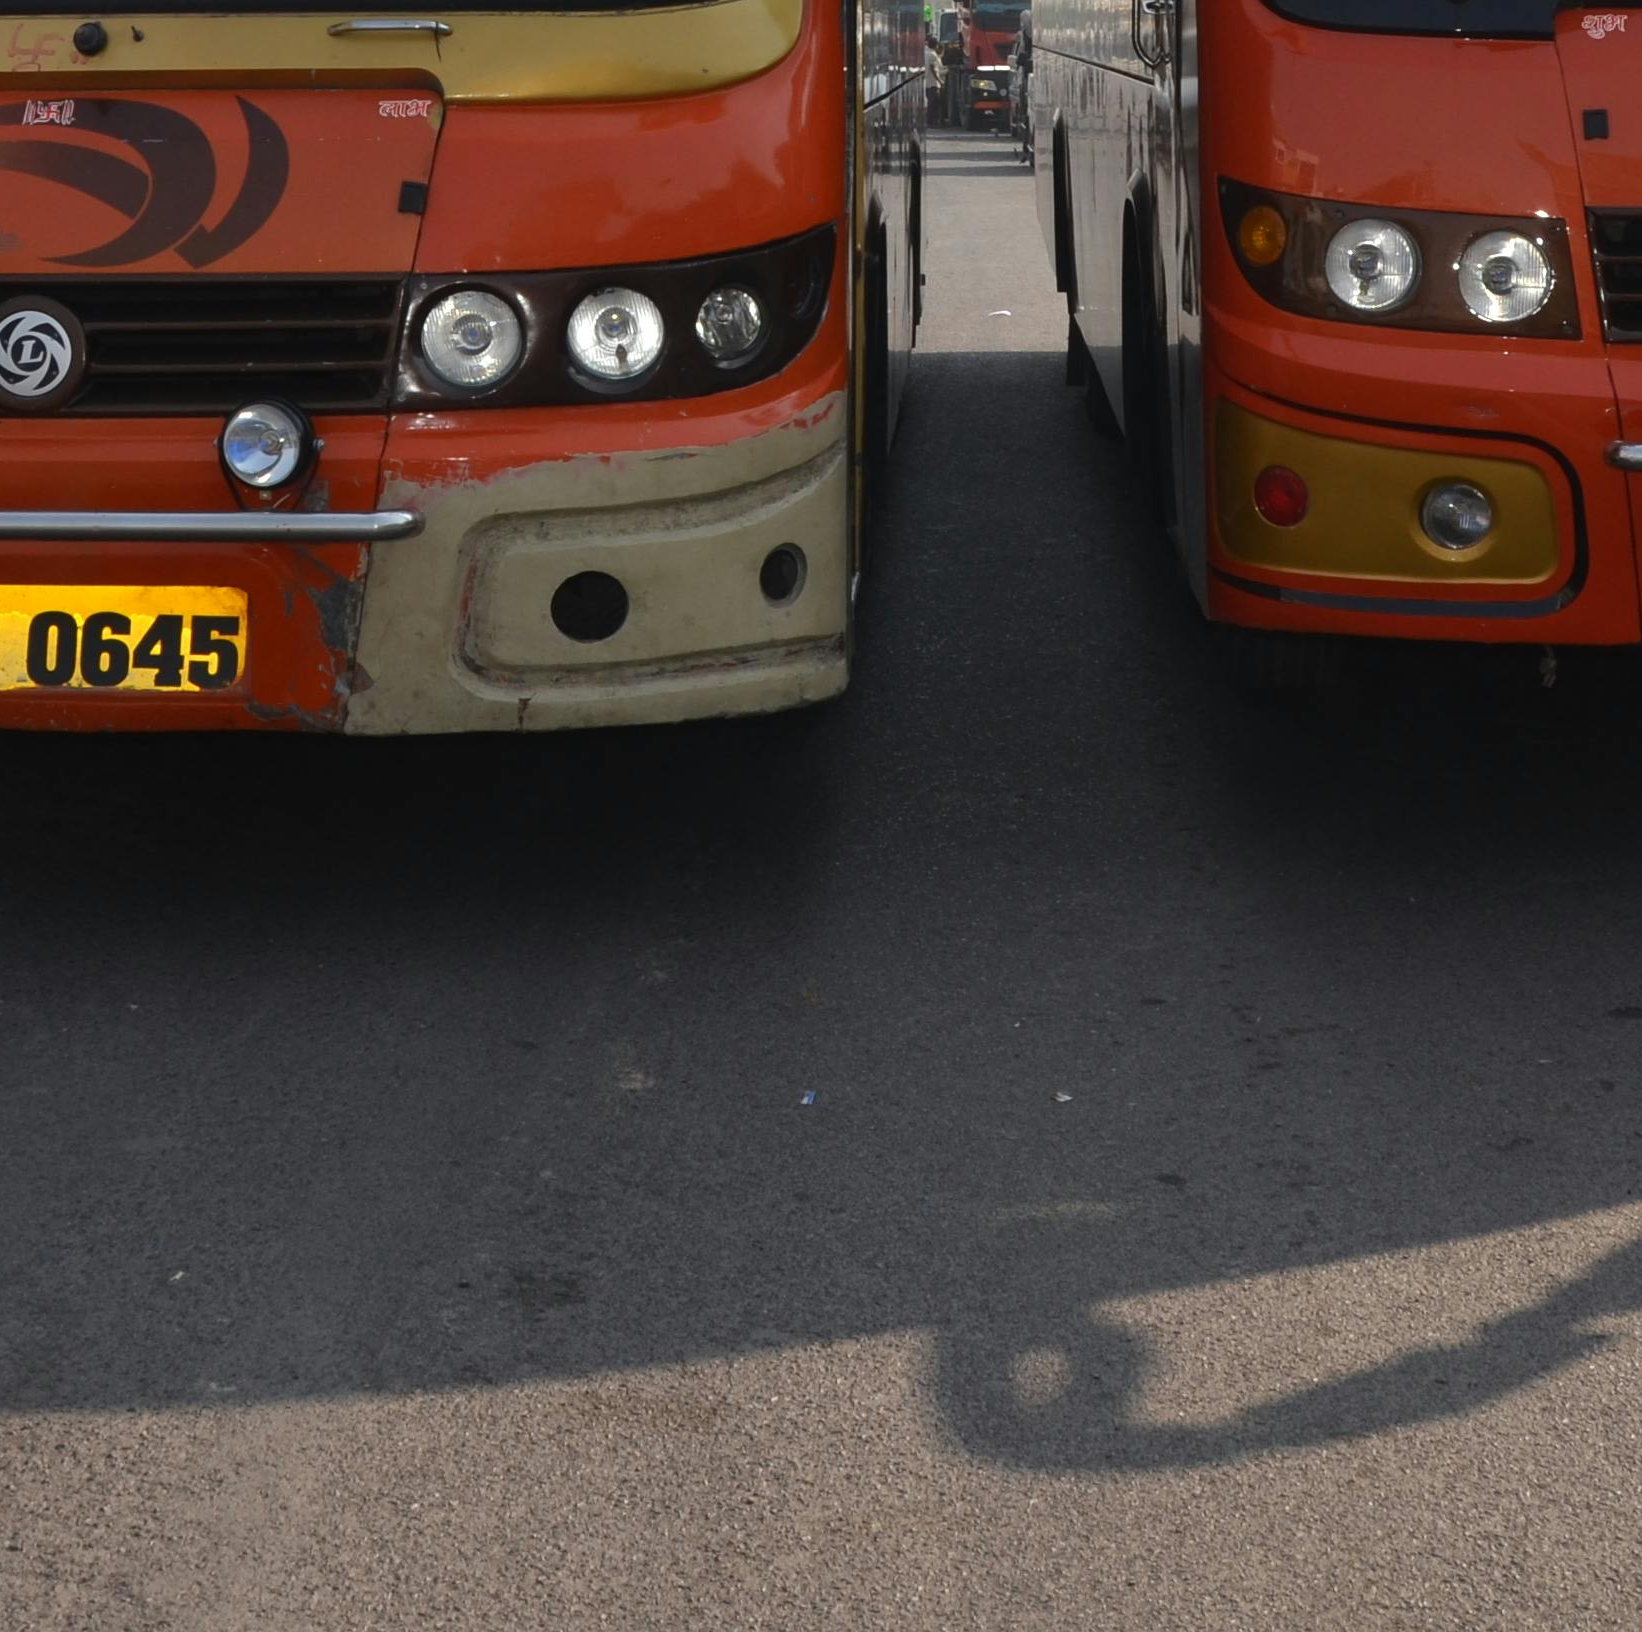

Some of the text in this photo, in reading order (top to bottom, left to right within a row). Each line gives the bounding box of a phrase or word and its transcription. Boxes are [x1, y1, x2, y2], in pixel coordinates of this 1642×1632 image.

[1581, 13, 1628, 39] शुभ
[379, 99, 432, 118] लाभ
[26, 611, 240, 690] 0645
